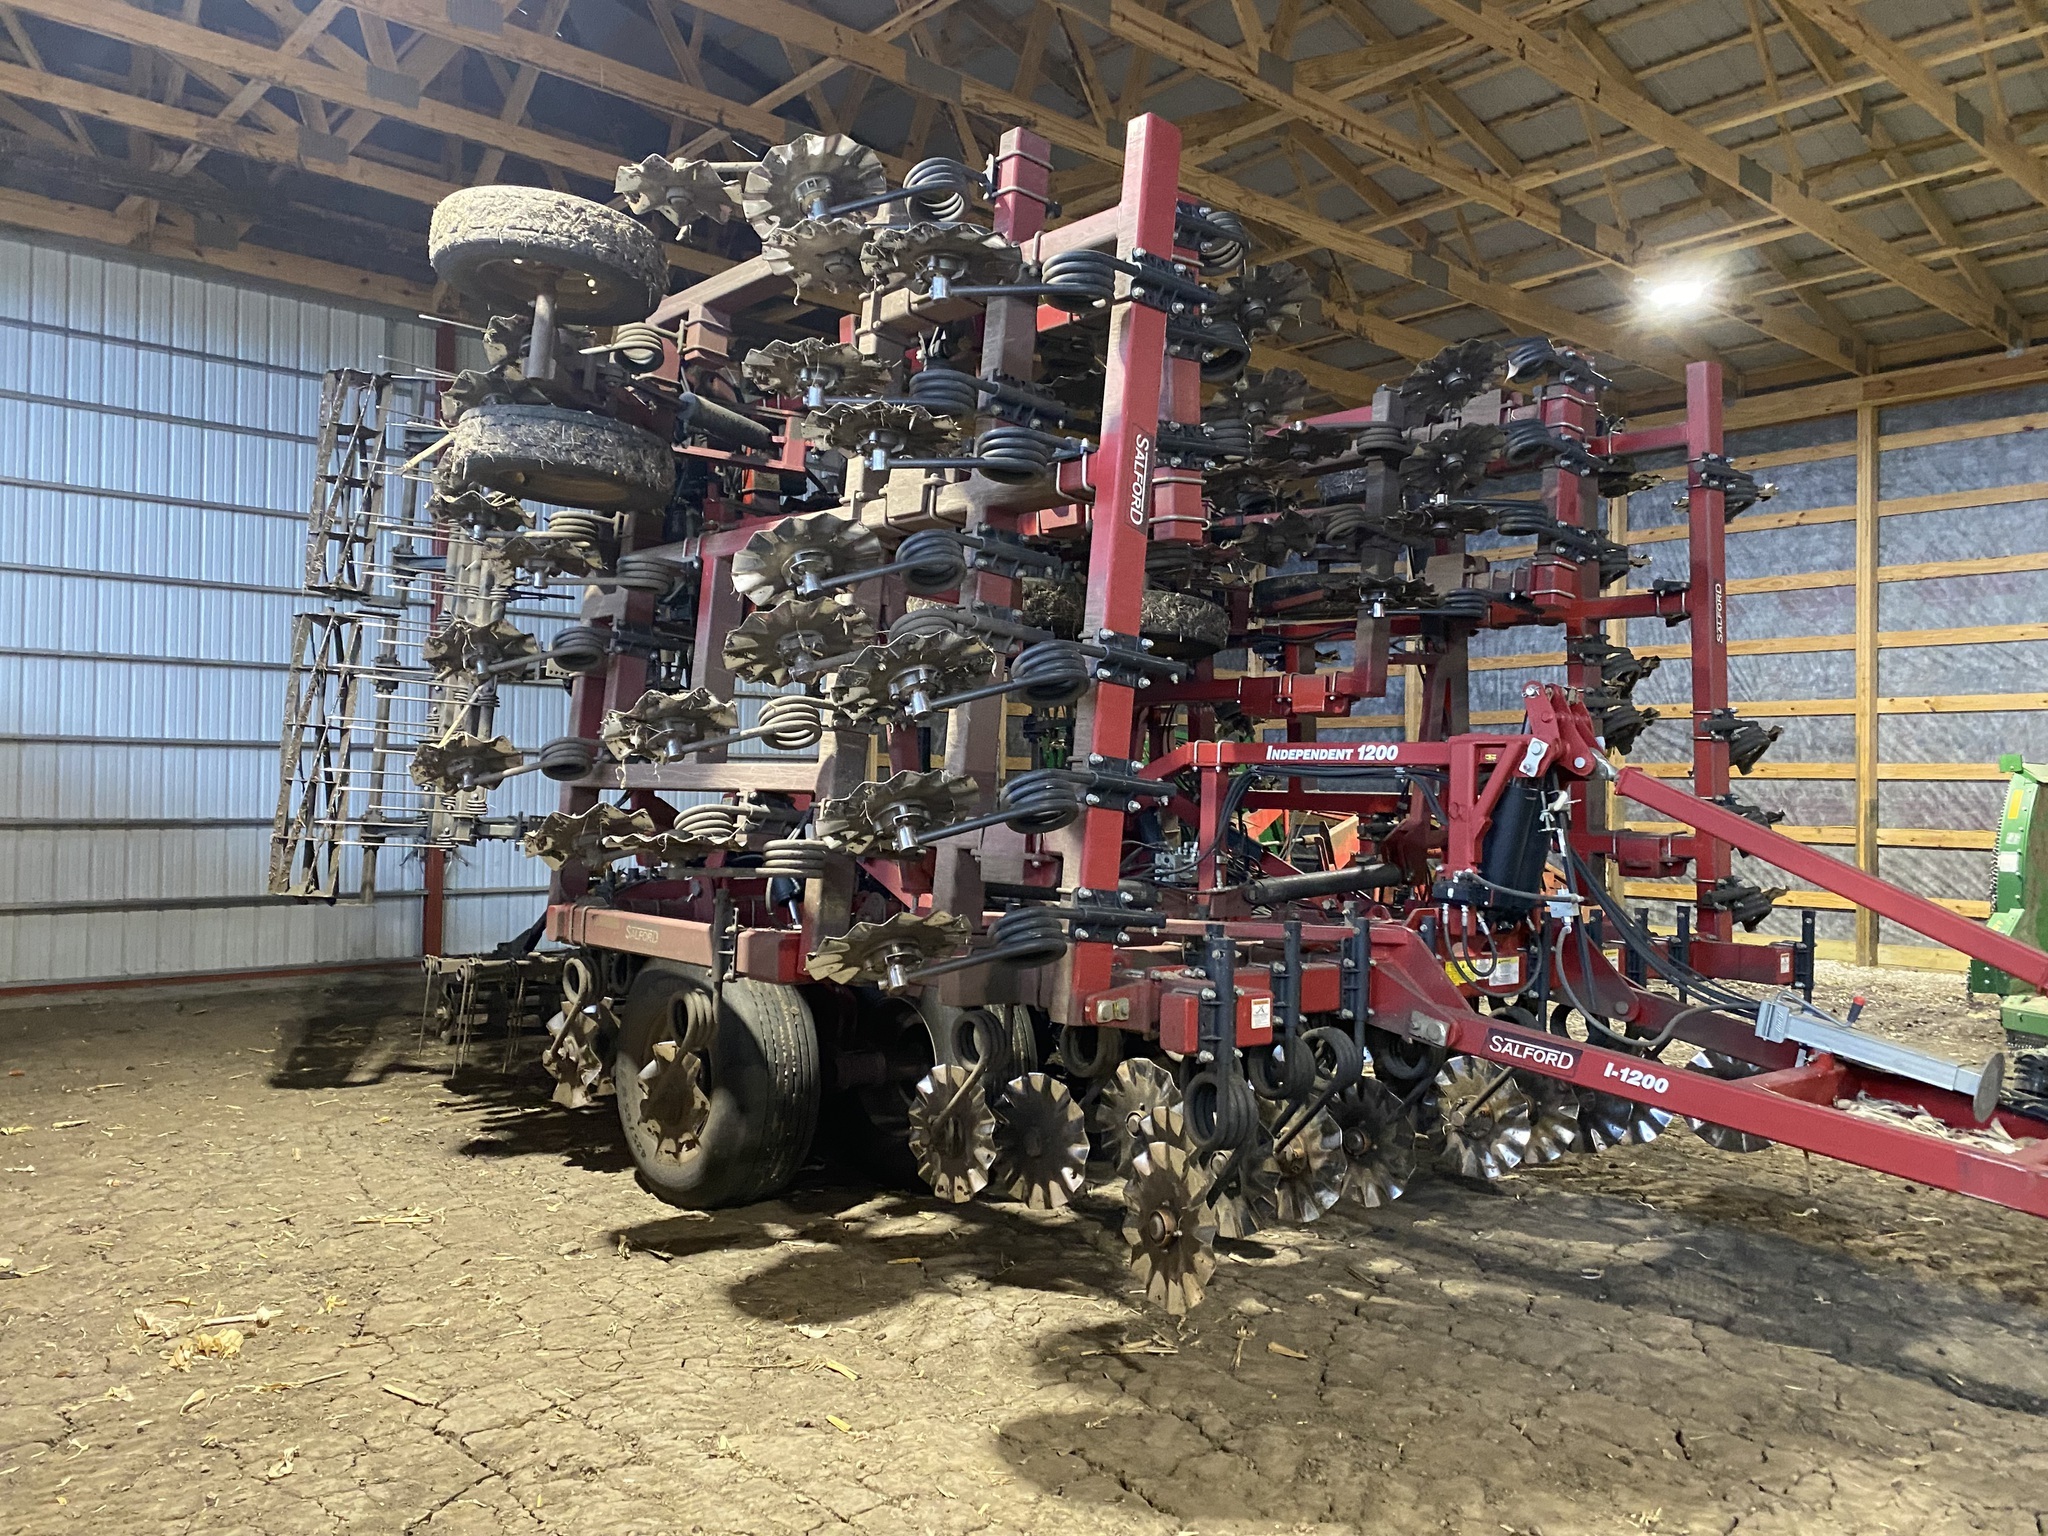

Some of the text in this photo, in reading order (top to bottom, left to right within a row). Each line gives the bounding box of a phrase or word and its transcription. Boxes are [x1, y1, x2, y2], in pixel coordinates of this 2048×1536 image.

[1130, 433, 1150, 526] SALFORD
[1714, 583, 1724, 644] SALFORD
[1265, 744, 1399, 761] INDEPENDENT 1200
[624, 924, 660, 944] SALFORD
[1488, 1035, 1575, 1071] SALFORD
[1603, 1061, 1670, 1095] I-1200
